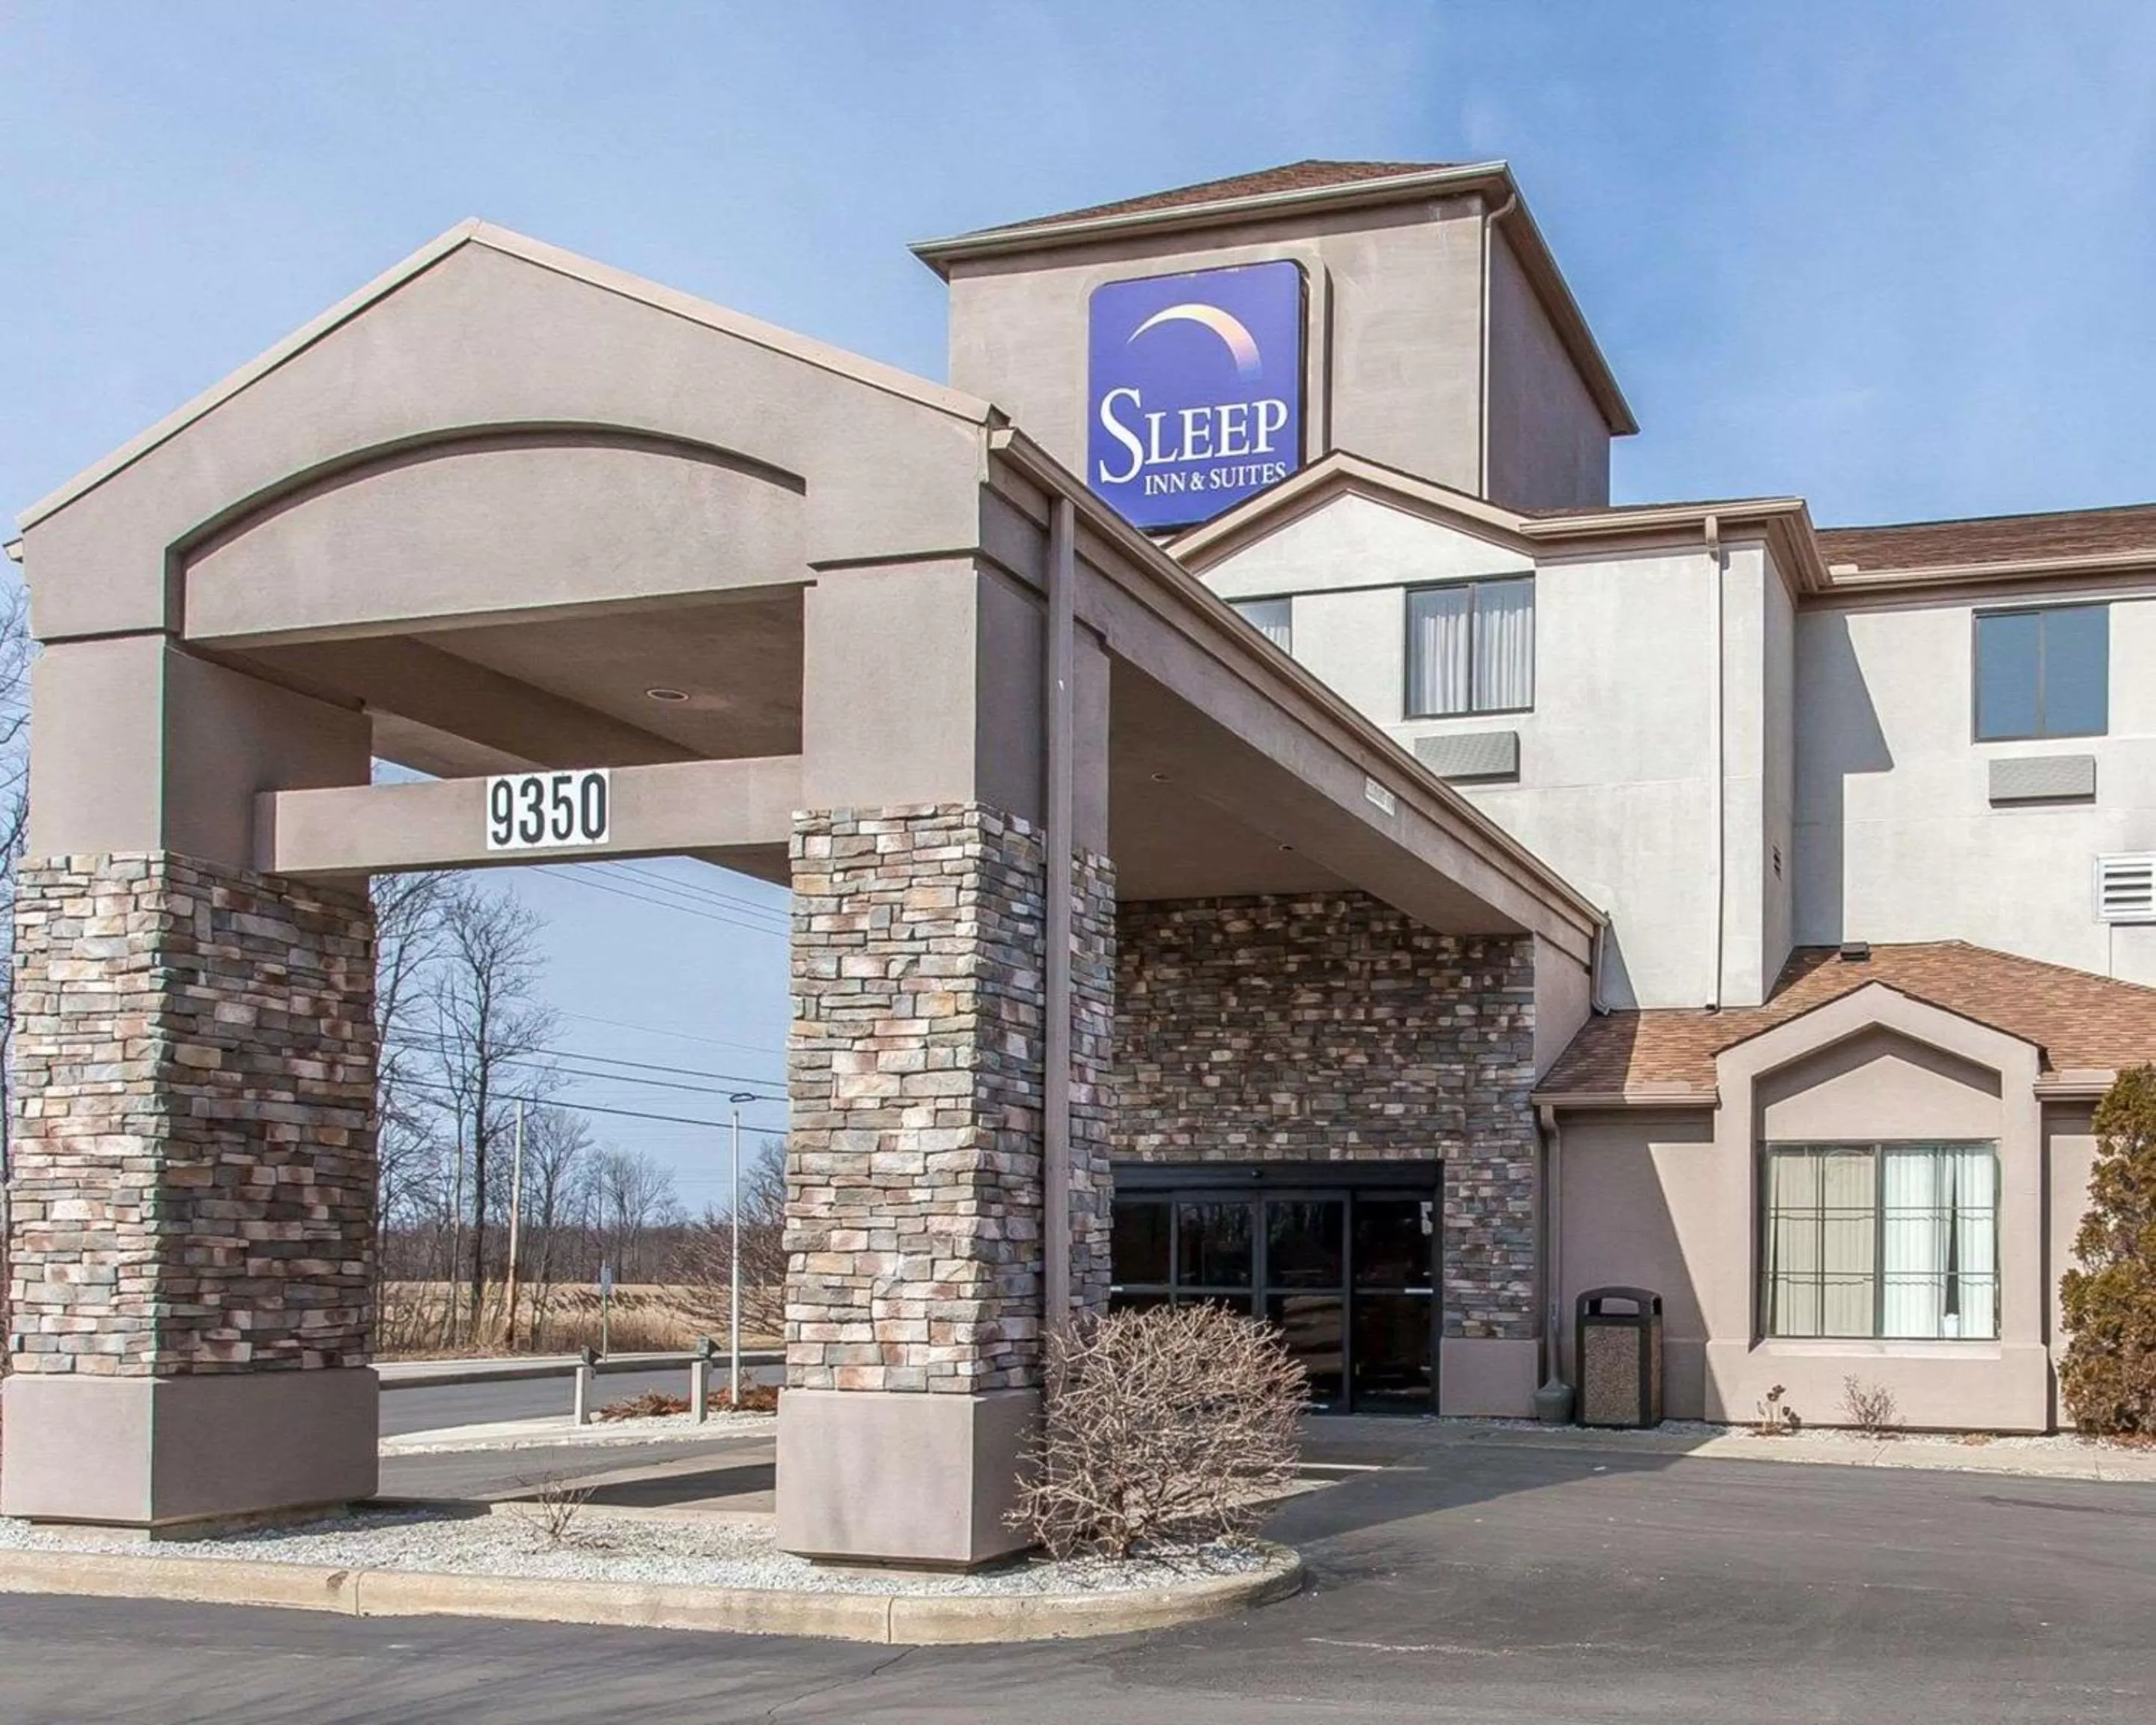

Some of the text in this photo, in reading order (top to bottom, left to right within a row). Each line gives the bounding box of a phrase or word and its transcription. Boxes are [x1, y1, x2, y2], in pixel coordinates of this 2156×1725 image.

[1099, 388, 1288, 483] SLEEP
[1145, 462, 1286, 495] INN & SUITES
[491, 773, 606, 846] 9350
